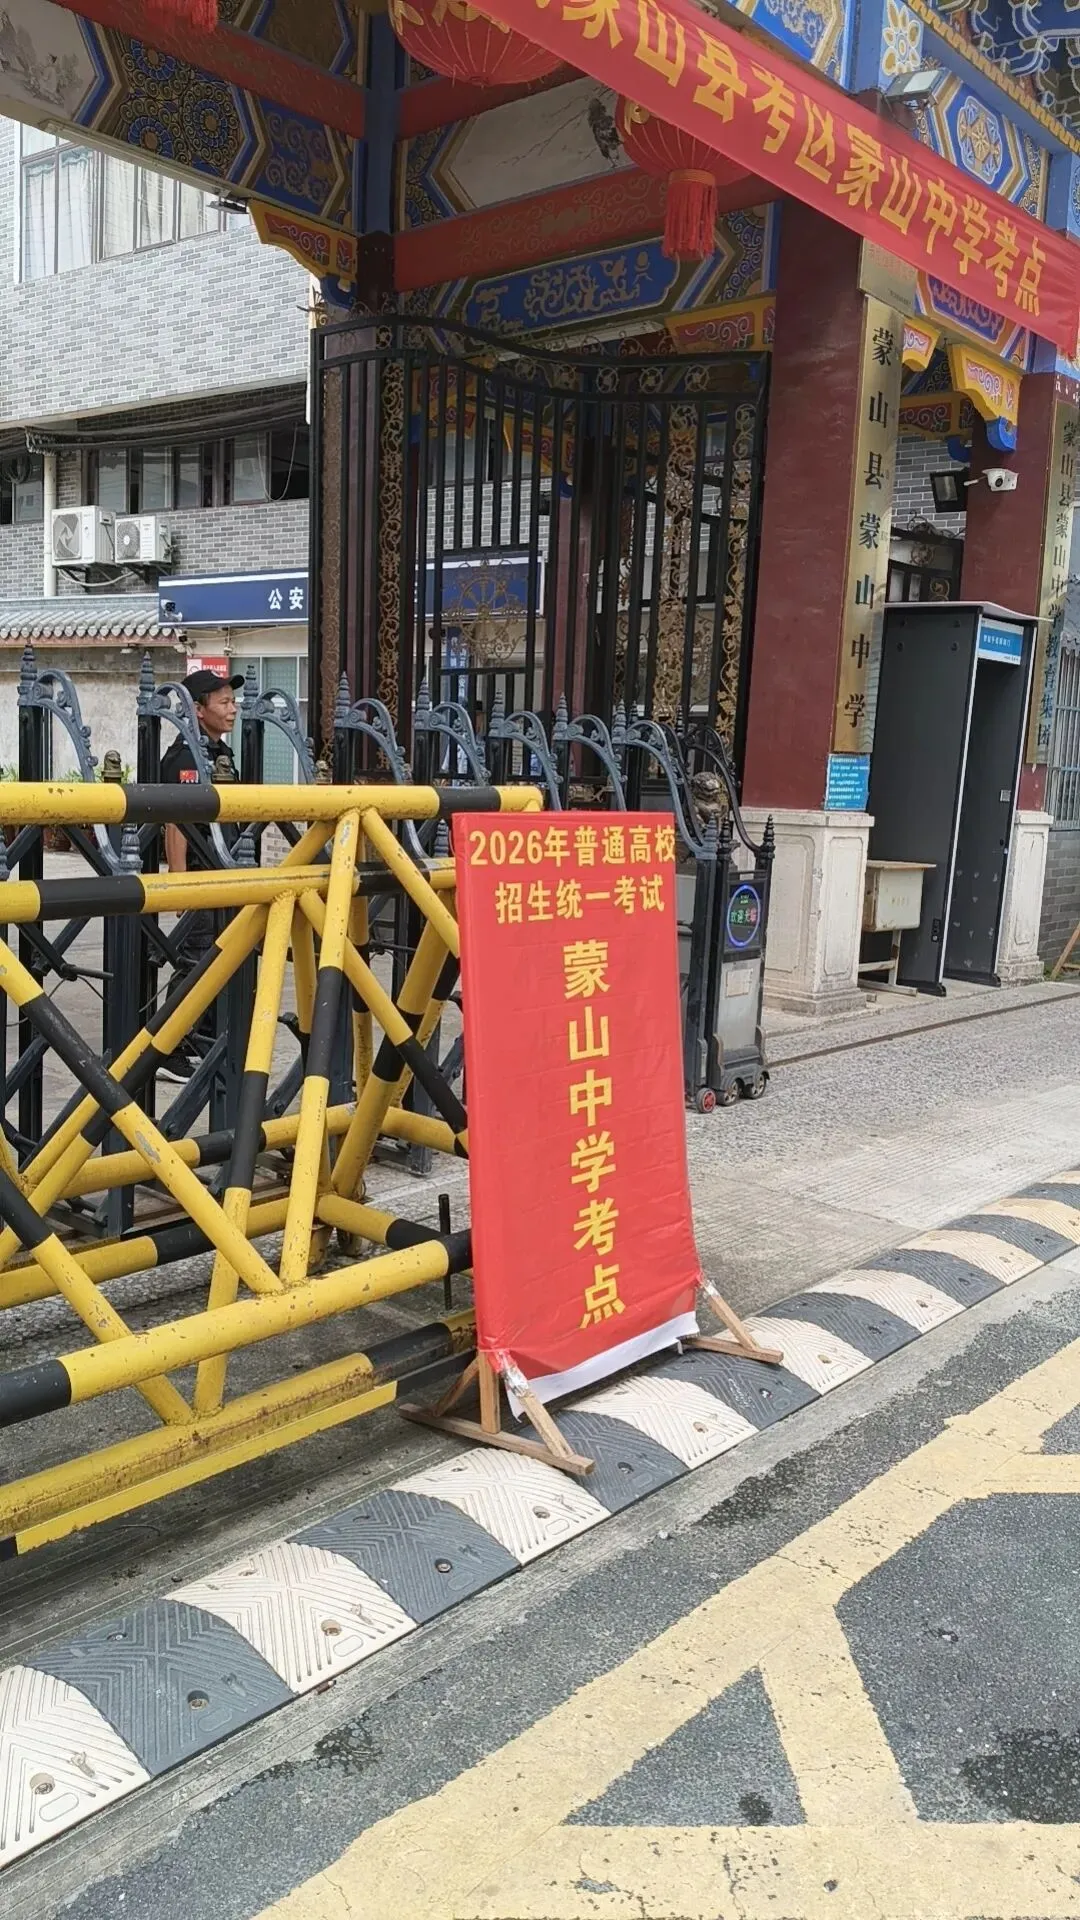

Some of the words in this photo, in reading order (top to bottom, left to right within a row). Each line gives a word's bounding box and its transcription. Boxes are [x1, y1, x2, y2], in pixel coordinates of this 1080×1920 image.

[268, 586, 304, 610] 公安
[844, 328, 895, 728] 蒙山县蒙山中学
[1037, 420, 1077, 746] 蒙山县蒙山中学教育集团
[469, 825, 676, 867] 2026年普通高校
[495, 874, 666, 924] 招生统一考试
[562, 940, 626, 1330] 蒙山中学考点
